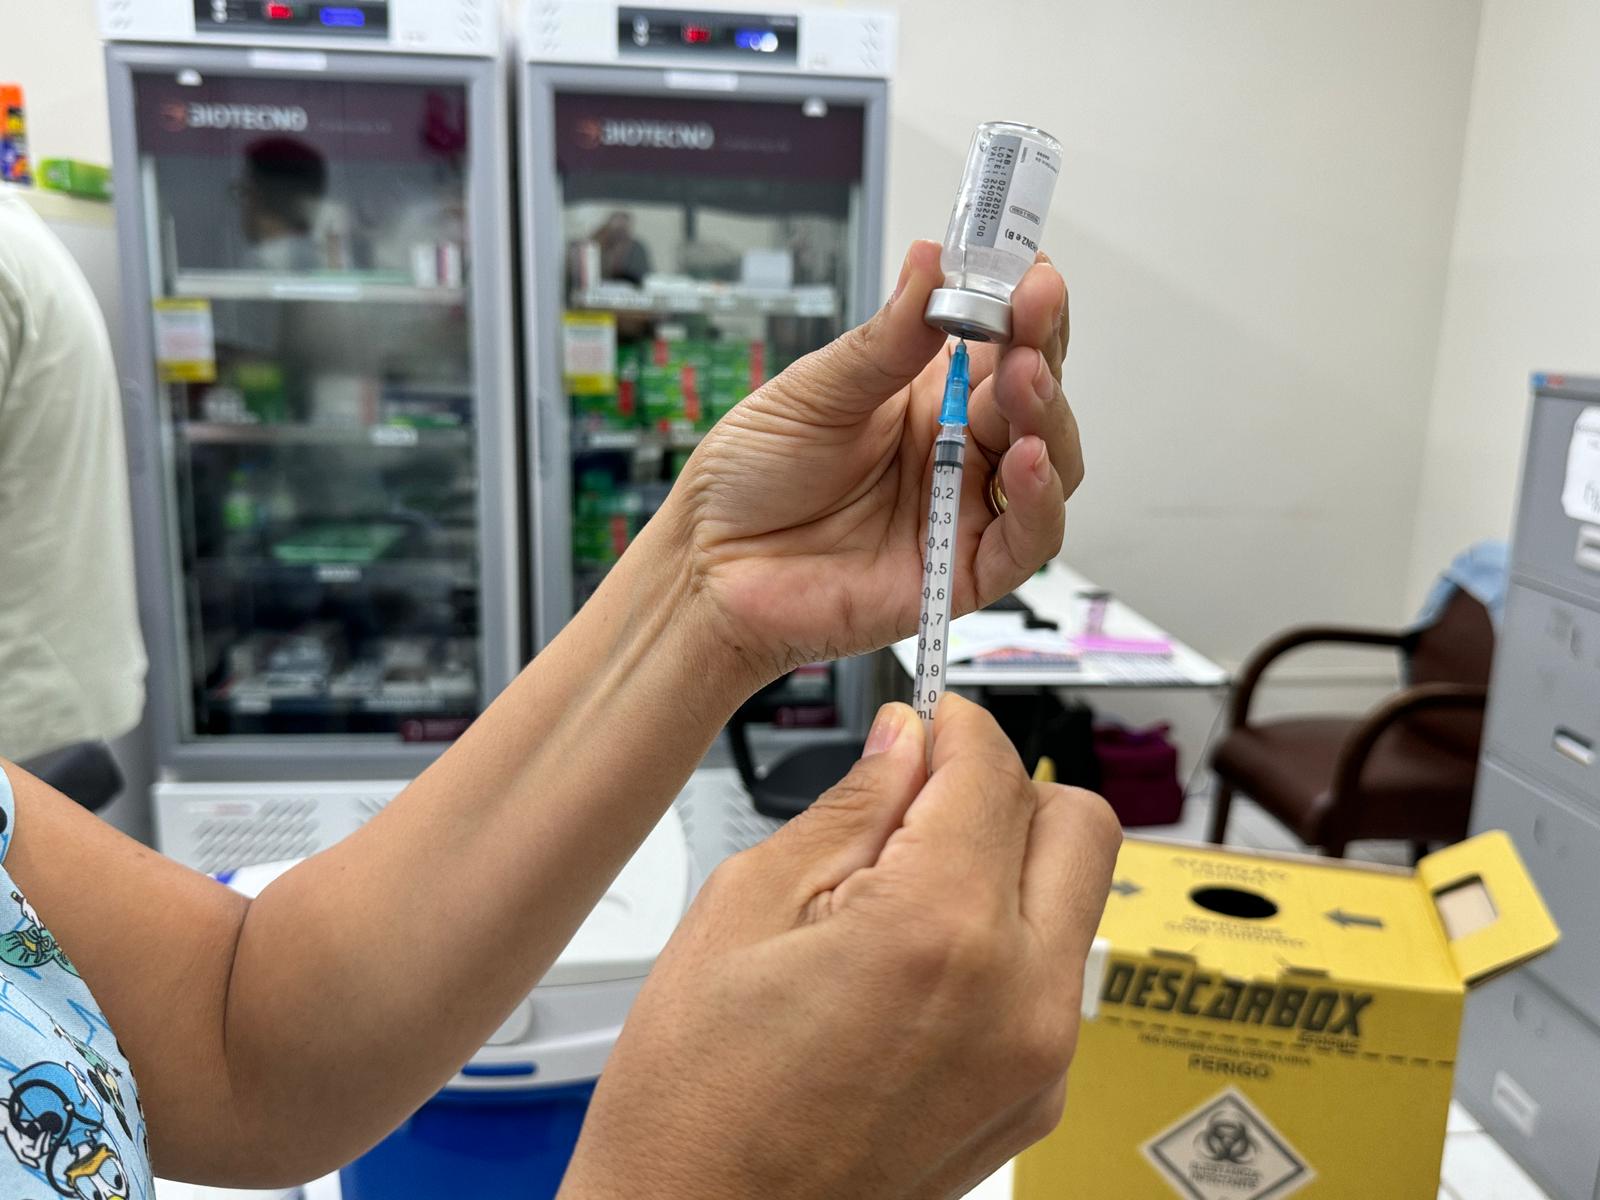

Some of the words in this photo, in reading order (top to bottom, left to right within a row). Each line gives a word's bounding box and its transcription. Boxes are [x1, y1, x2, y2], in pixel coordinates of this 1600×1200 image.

[991, 180, 1006, 220] 02/2024
[933, 486, 954, 500] 0,2
[930, 511, 952, 525] 0,3
[928, 536, 949, 550] 0,4
[926, 561, 947, 575] 0,5
[923, 587, 945, 601] 0,6
[922, 612, 943, 626] 0,7
[920, 638, 941, 652] 0,8
[917, 663, 939, 678] 0,9
[916, 690, 937, 703] 1,0
[917, 709, 935, 720] mL
